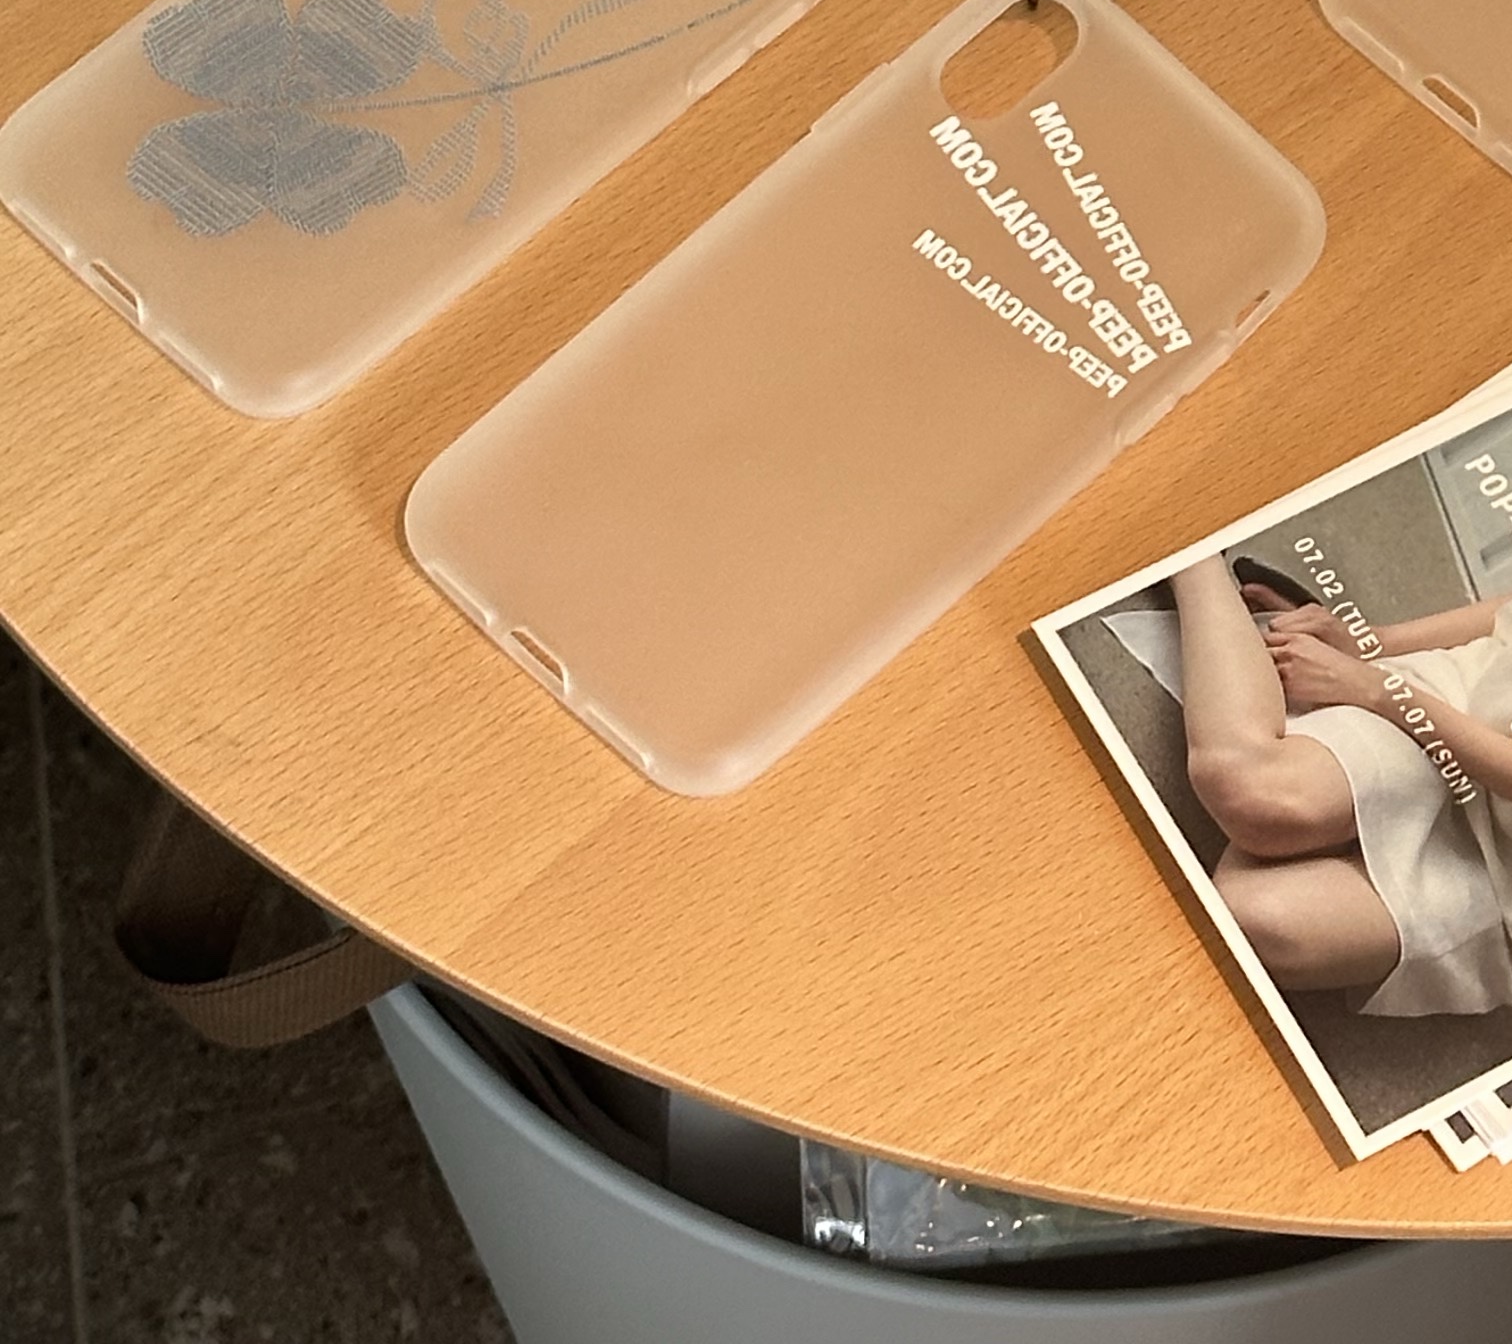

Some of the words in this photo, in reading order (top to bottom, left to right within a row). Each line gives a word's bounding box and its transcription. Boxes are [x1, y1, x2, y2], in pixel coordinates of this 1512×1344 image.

[1294, 536, 1345, 600] 07.02
[1331, 600, 1385, 661] (TUE)
[1383, 674, 1436, 736] 07.07
[1423, 739, 1478, 805] (SUN)
